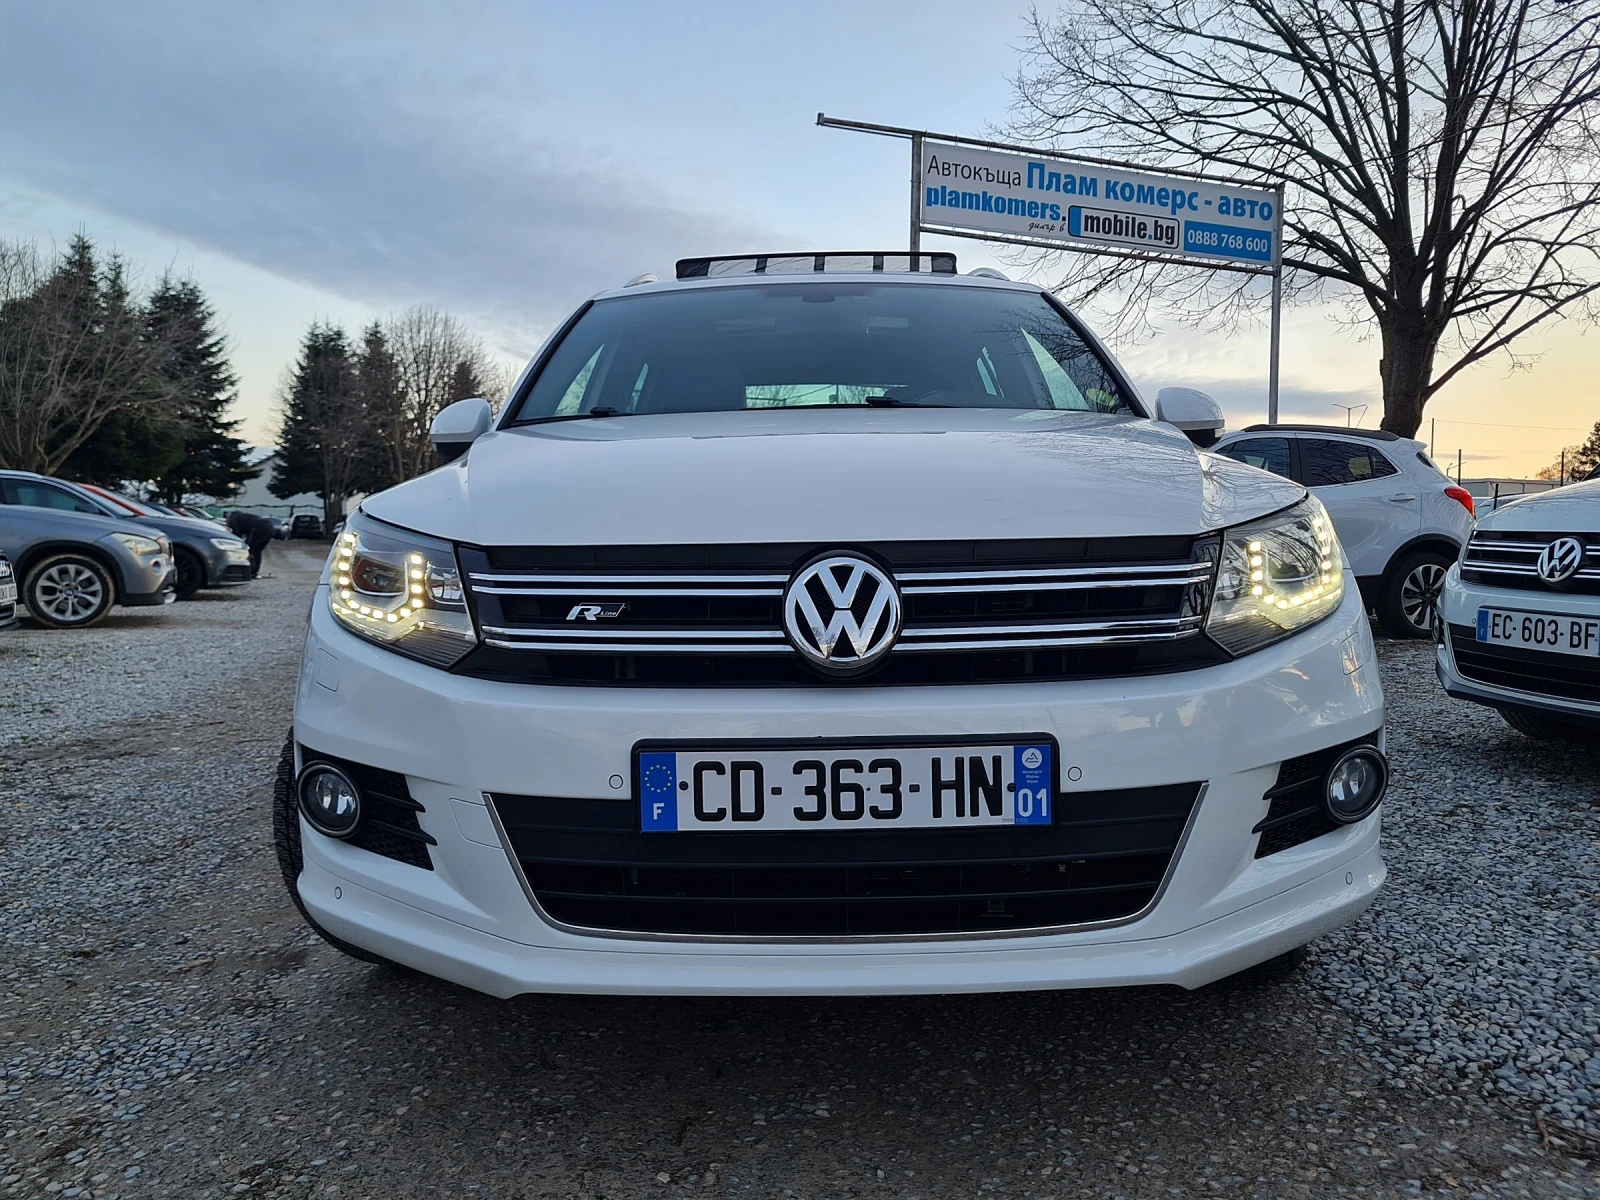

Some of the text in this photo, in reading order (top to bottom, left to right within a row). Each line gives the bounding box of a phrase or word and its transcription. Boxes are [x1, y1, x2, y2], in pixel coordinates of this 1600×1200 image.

[927, 155, 1021, 189] Автокъща
[1027, 161, 1098, 198] Плам
[1105, 179, 1199, 215] комерс
[1218, 195, 1273, 221] авто
[1083, 213, 1175, 245] mobile.bg
[1187, 229, 1268, 253] 0888 768 600
[566, 606, 601, 620] R
[1491, 613, 1598, 650] EC-603-BF
[693, 756, 1003, 822] CD-363-HN
[1018, 788, 1047, 817] 01
[653, 803, 664, 820] F
